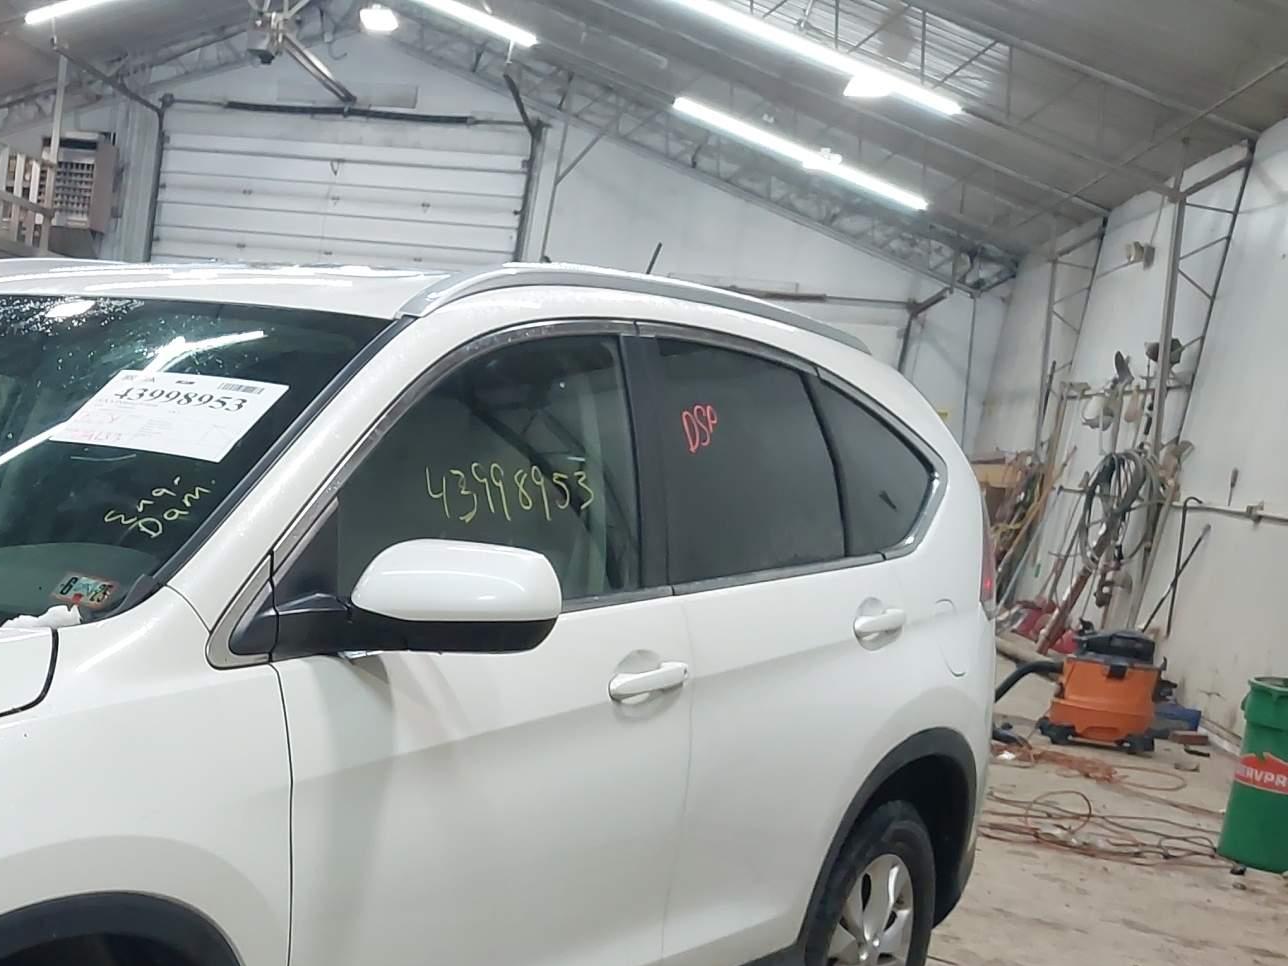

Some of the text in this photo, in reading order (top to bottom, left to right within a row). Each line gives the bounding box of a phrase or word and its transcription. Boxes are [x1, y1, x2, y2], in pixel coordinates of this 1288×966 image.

[114, 387, 247, 412] 43998953
[682, 404, 718, 453] DSP
[425, 462, 594, 523] 43998953
